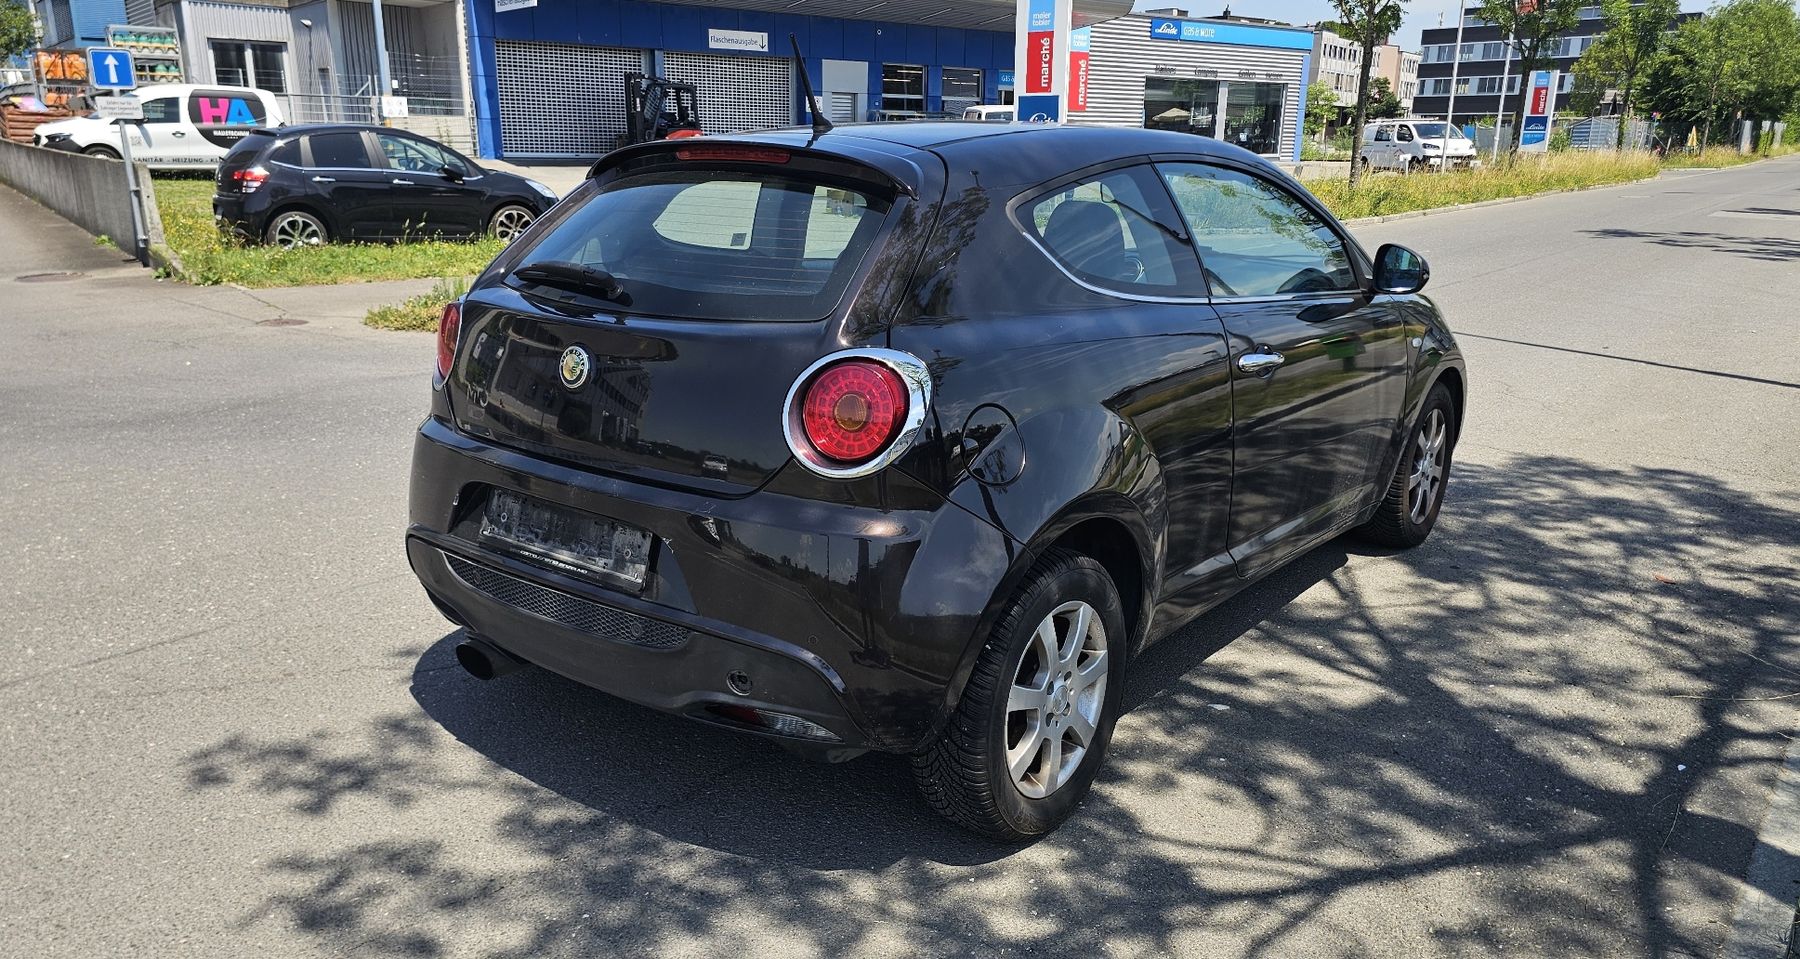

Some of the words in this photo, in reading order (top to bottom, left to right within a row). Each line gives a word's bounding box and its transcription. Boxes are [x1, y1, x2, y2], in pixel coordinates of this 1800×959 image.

[1032, 11, 1052, 20] meier
[1155, 22, 1179, 35] Linde
[710, 35, 758, 46] Flaschenausgabe
[1040, 37, 1050, 88] marché
[1078, 59, 1087, 105] marché
[198, 97, 258, 127] HA
[133, 155, 163, 163] SANITÄR
